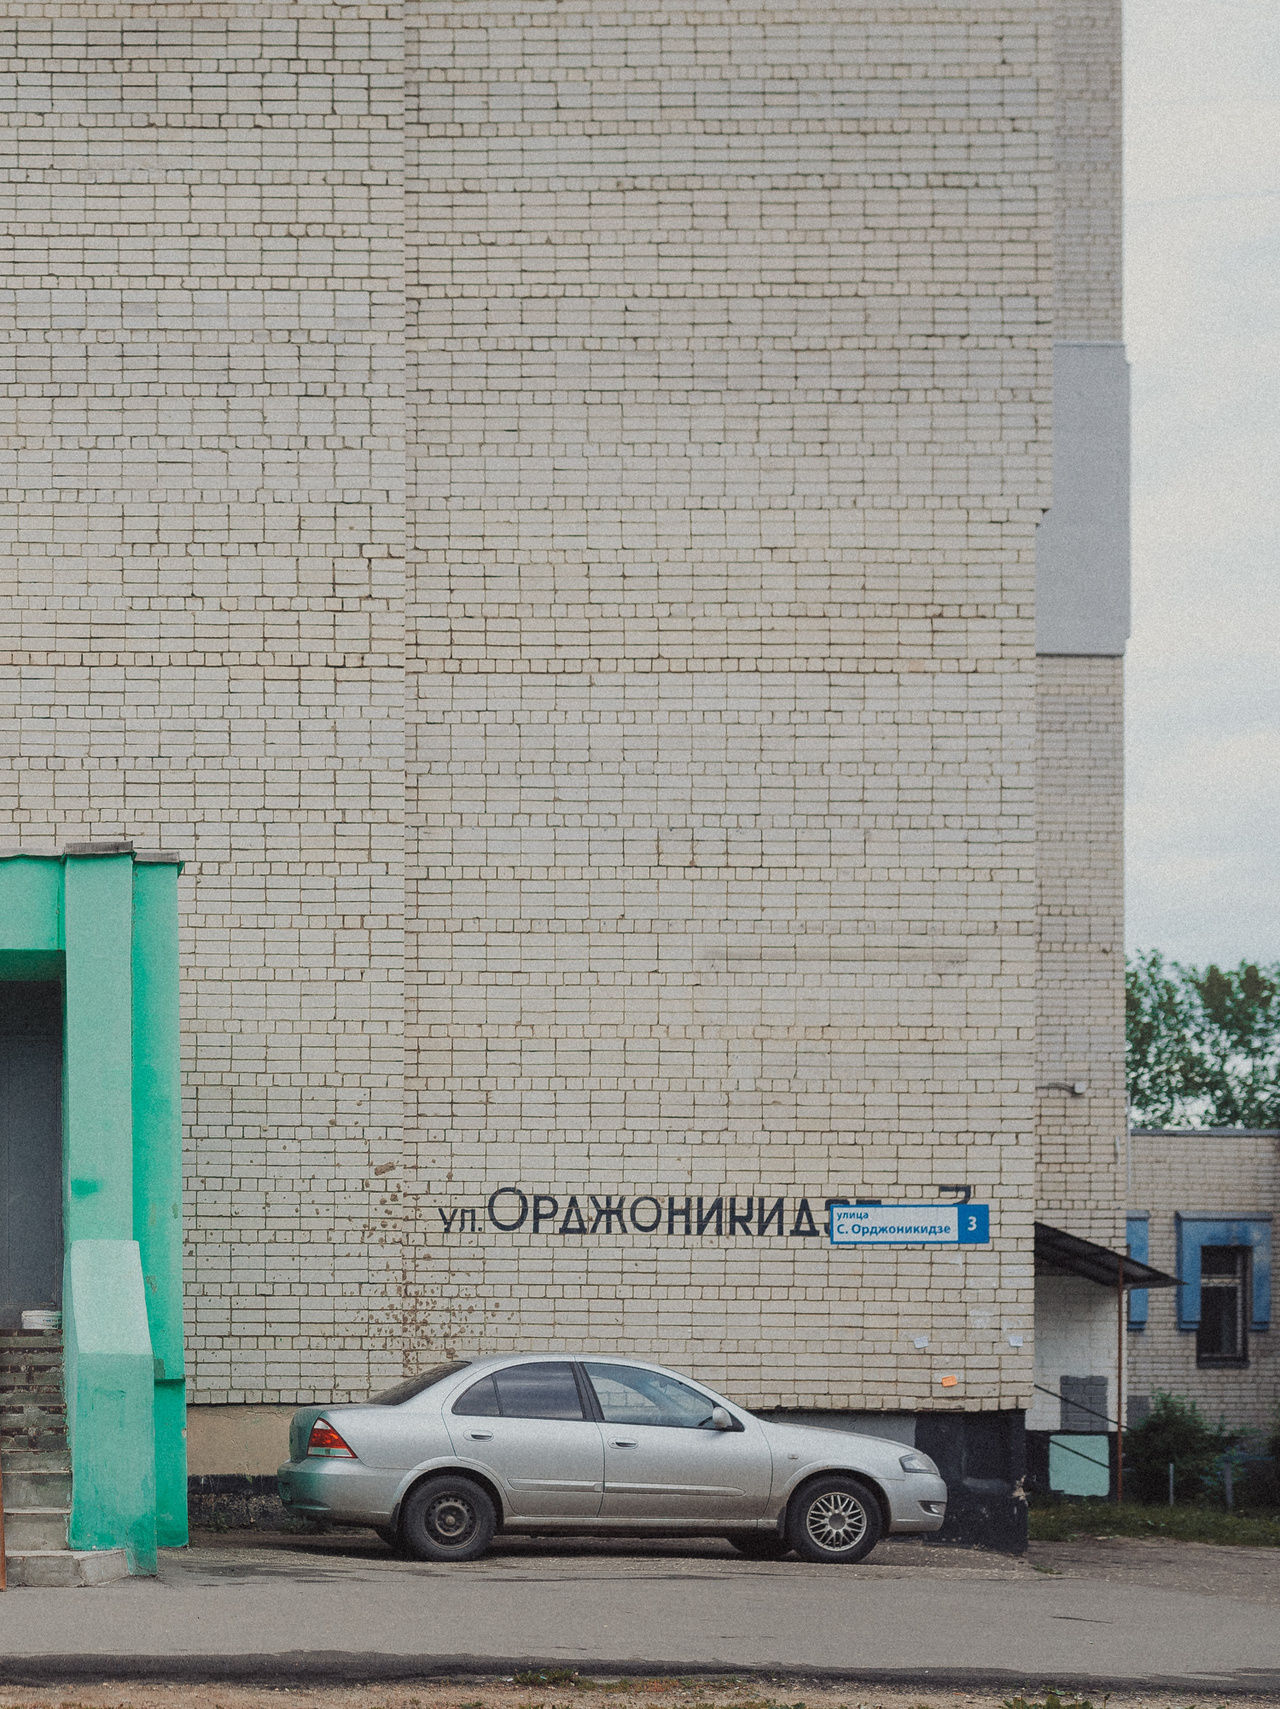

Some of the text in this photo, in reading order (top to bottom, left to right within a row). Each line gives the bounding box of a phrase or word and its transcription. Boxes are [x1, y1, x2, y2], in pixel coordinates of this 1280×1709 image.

[438, 1187, 882, 1237] ул. ОРДЖОНИКИД
[837, 1212, 869, 1221] улица
[837, 1224, 951, 1236] С. Орджоникидзе
[967, 1216, 977, 1231] 3
